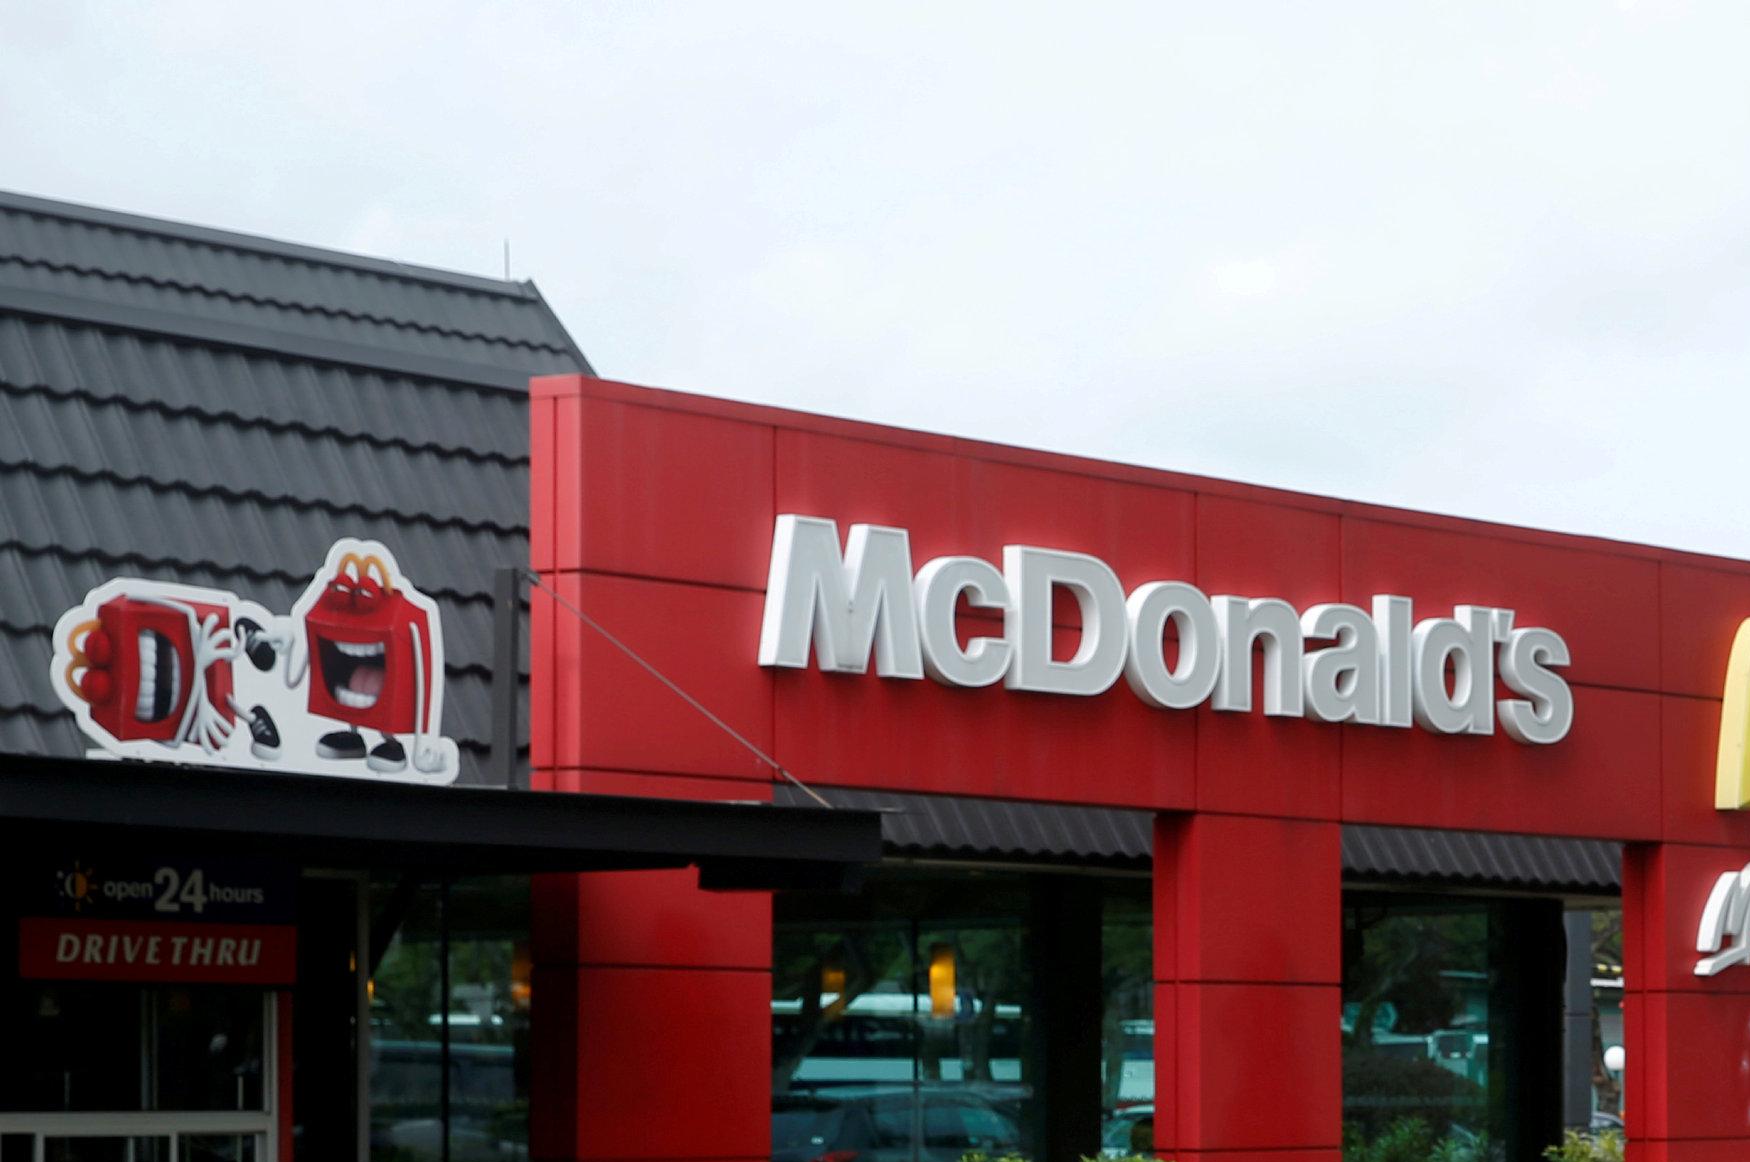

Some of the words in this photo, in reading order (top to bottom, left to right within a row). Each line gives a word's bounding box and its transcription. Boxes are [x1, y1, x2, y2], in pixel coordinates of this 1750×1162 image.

[757, 512, 1574, 745] McDonald's
[103, 880, 154, 900] open
[153, 866, 208, 914] 24
[208, 882, 265, 904] hours
[56, 932, 163, 965] DRIVE
[170, 936, 262, 967] THRU
